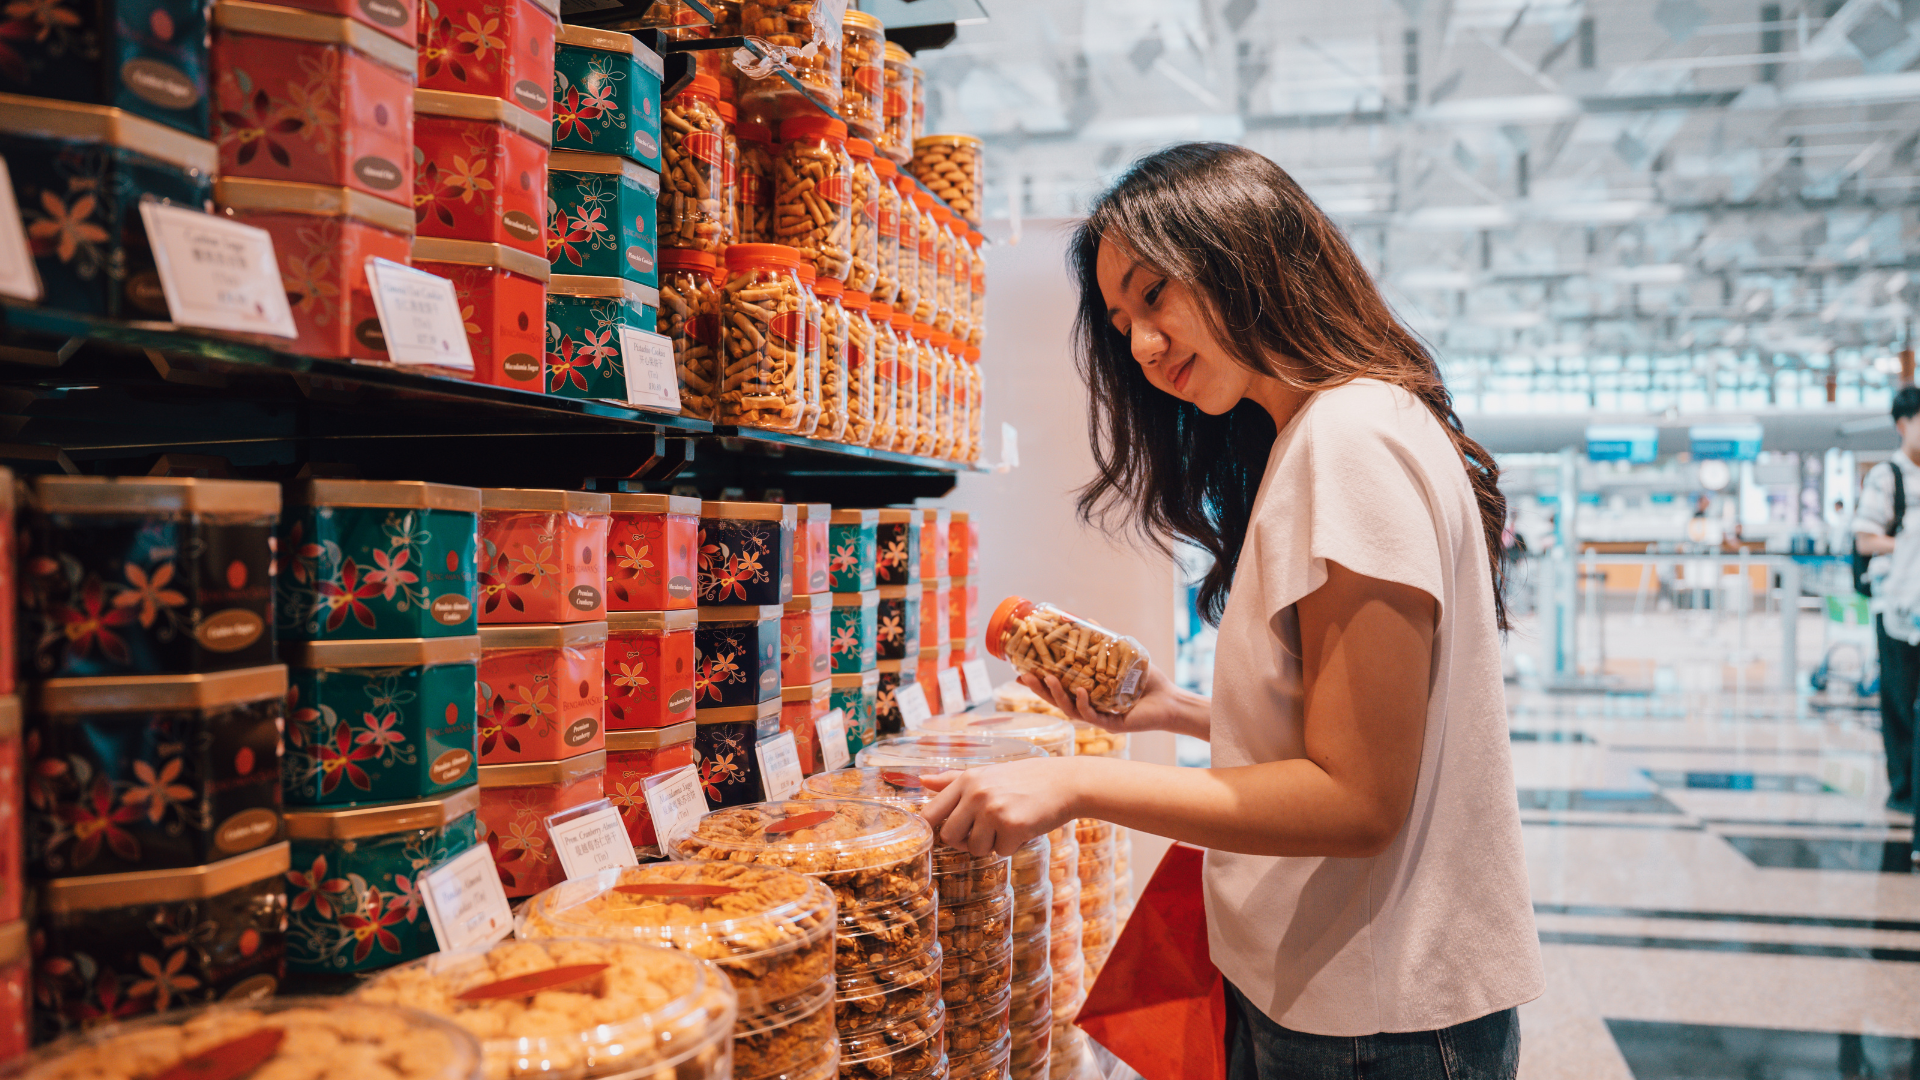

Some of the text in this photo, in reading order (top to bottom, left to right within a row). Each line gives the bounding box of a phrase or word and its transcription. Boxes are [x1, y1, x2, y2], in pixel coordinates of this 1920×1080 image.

[651, 346, 666, 358] Cookies
[577, 589, 594, 597] Premium
[576, 598, 594, 608] Cranberry
[573, 723, 590, 733] Premium
[572, 731, 591, 742] Cranberry
[578, 826, 602, 841] Cranberry
